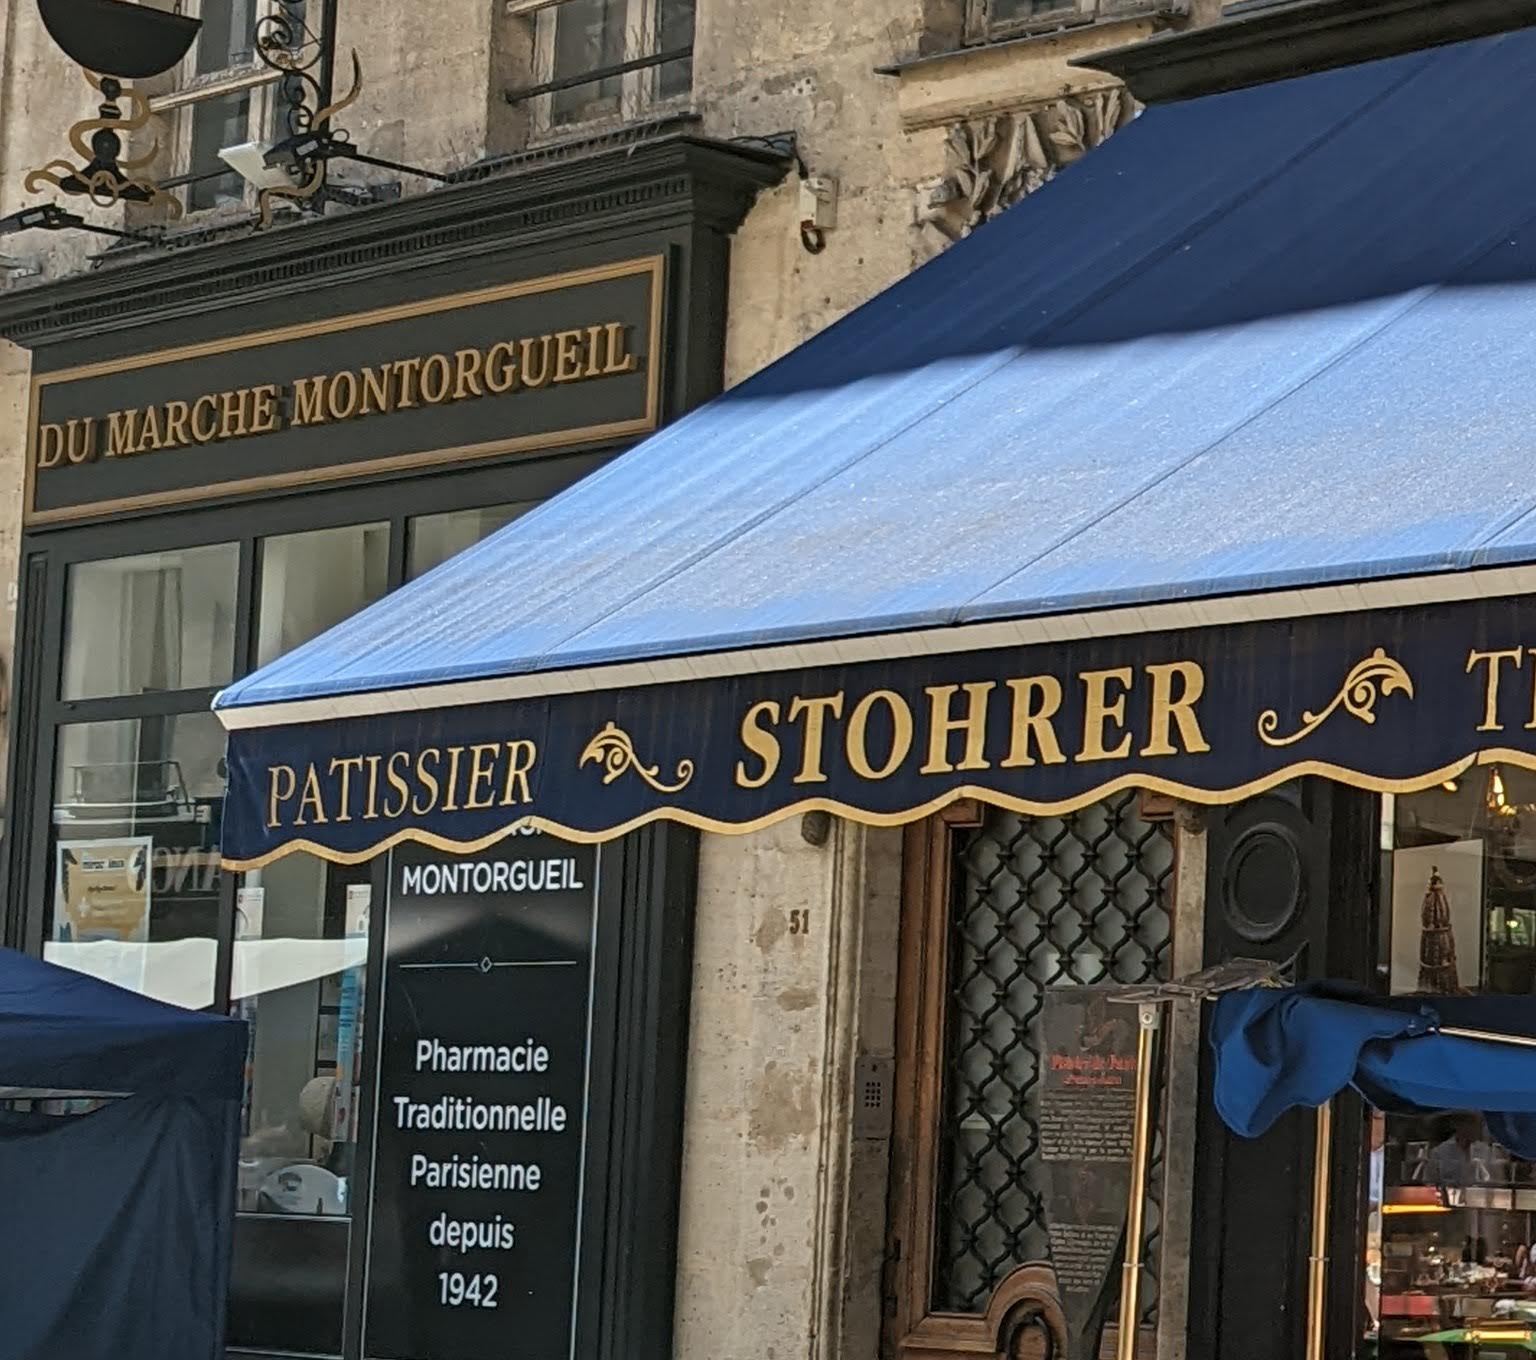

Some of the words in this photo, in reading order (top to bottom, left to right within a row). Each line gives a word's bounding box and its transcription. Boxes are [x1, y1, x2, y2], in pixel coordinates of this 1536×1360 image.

[38, 416, 93, 468] DU
[106, 384, 277, 457] MARCHE
[290, 322, 634, 426] MONTORGUEIL
[265, 739, 537, 829] PATISSIER
[736, 660, 1210, 789] STOHRER
[402, 858, 584, 895] MONTORGUEIL
[788, 908, 810, 935] 51
[415, 1038, 549, 1073] Pharmacie
[394, 1096, 567, 1133] Traditionnelle
[411, 1155, 541, 1191] Parisienne
[429, 1213, 515, 1253] depuis
[438, 1272, 498, 1307] 1942
